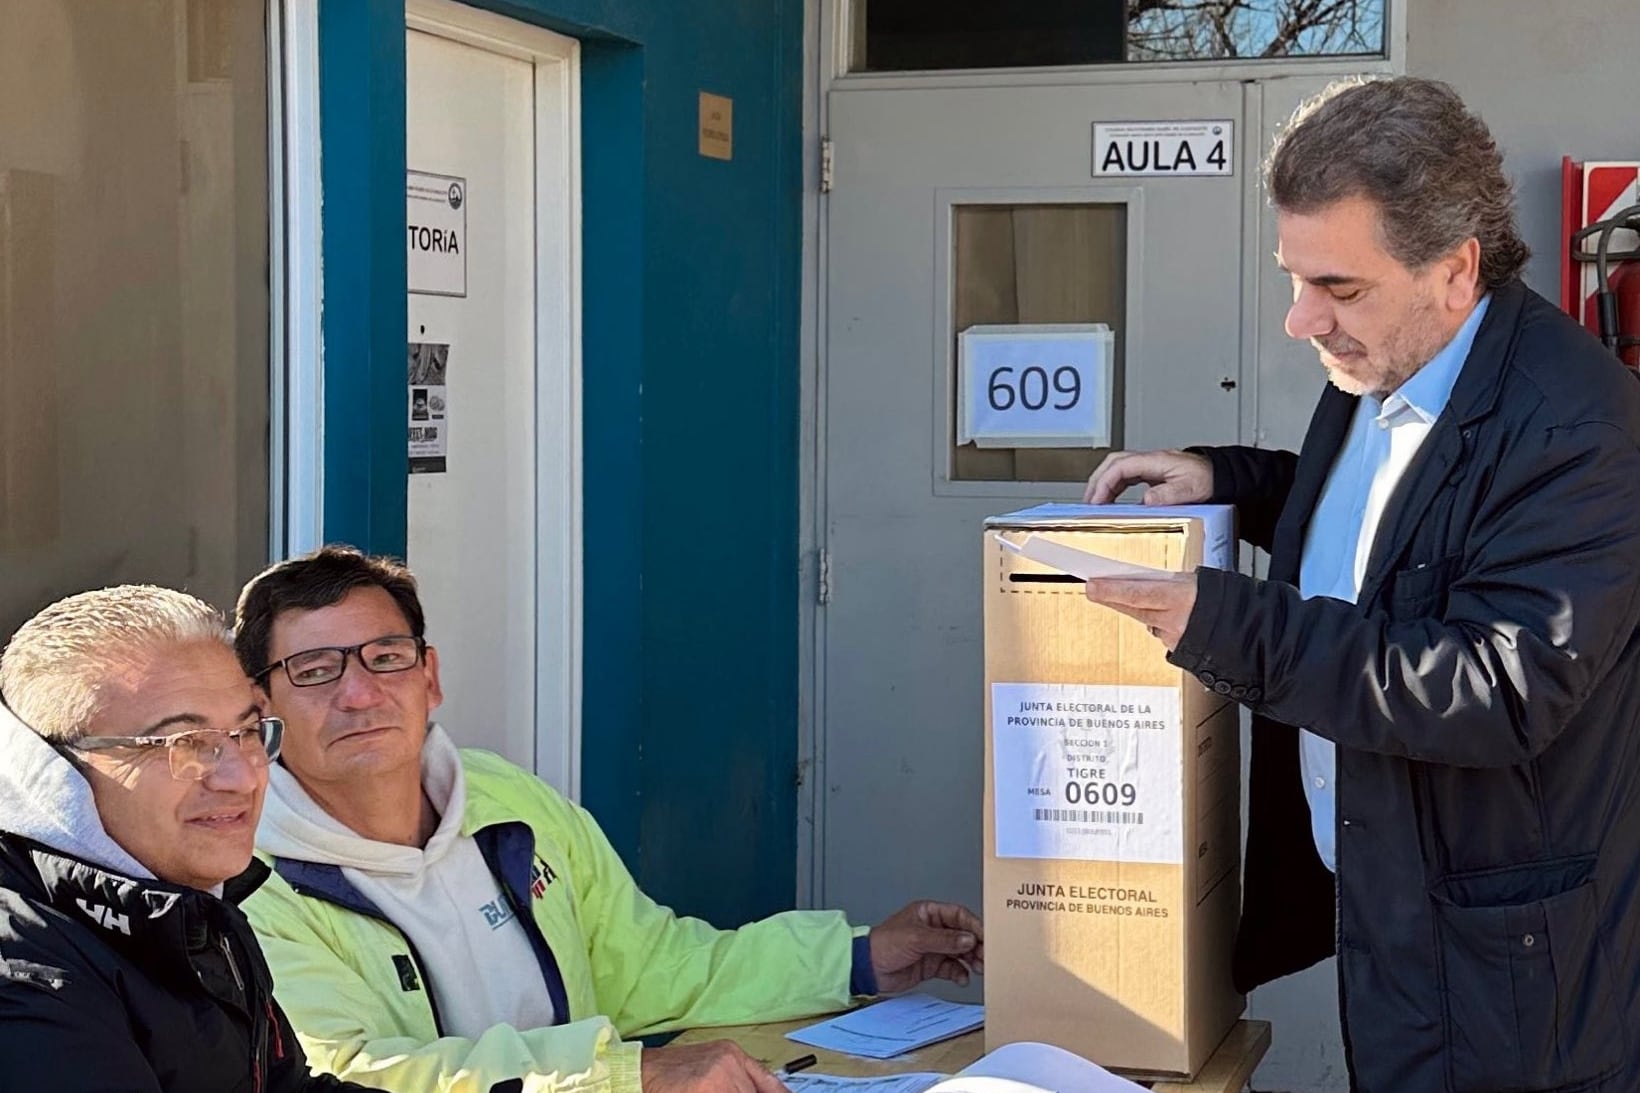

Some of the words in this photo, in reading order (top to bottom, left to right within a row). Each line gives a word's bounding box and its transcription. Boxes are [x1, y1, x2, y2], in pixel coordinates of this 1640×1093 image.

[1102, 140, 1197, 172] AULA
[1206, 139, 1227, 171] 4
[987, 365, 1081, 411] 609
[1019, 701, 1053, 712] JUNTA
[1056, 703, 1118, 714] ELECTORAL
[1120, 704, 1136, 714] DE
[1138, 704, 1151, 714] LA
[1007, 716, 1065, 728] PROVINCIA
[1068, 717, 1084, 728] DE
[1086, 718, 1130, 729] BUENOS
[1134, 719, 1166, 730] AIRES
[1066, 754, 1107, 763] DISTRITO
[1066, 768, 1107, 779] TIGRE
[1027, 788, 1051, 797] MESA
[1065, 781, 1136, 806] 0609
[1016, 883, 1066, 898] JUNTA
[1069, 886, 1157, 903] ELECTORAL
[1006, 899, 1066, 912] PROVINCIA
[1068, 902, 1084, 913] DE
[1086, 903, 1132, 917] BUENOS
[1134, 906, 1169, 919] AIRES
